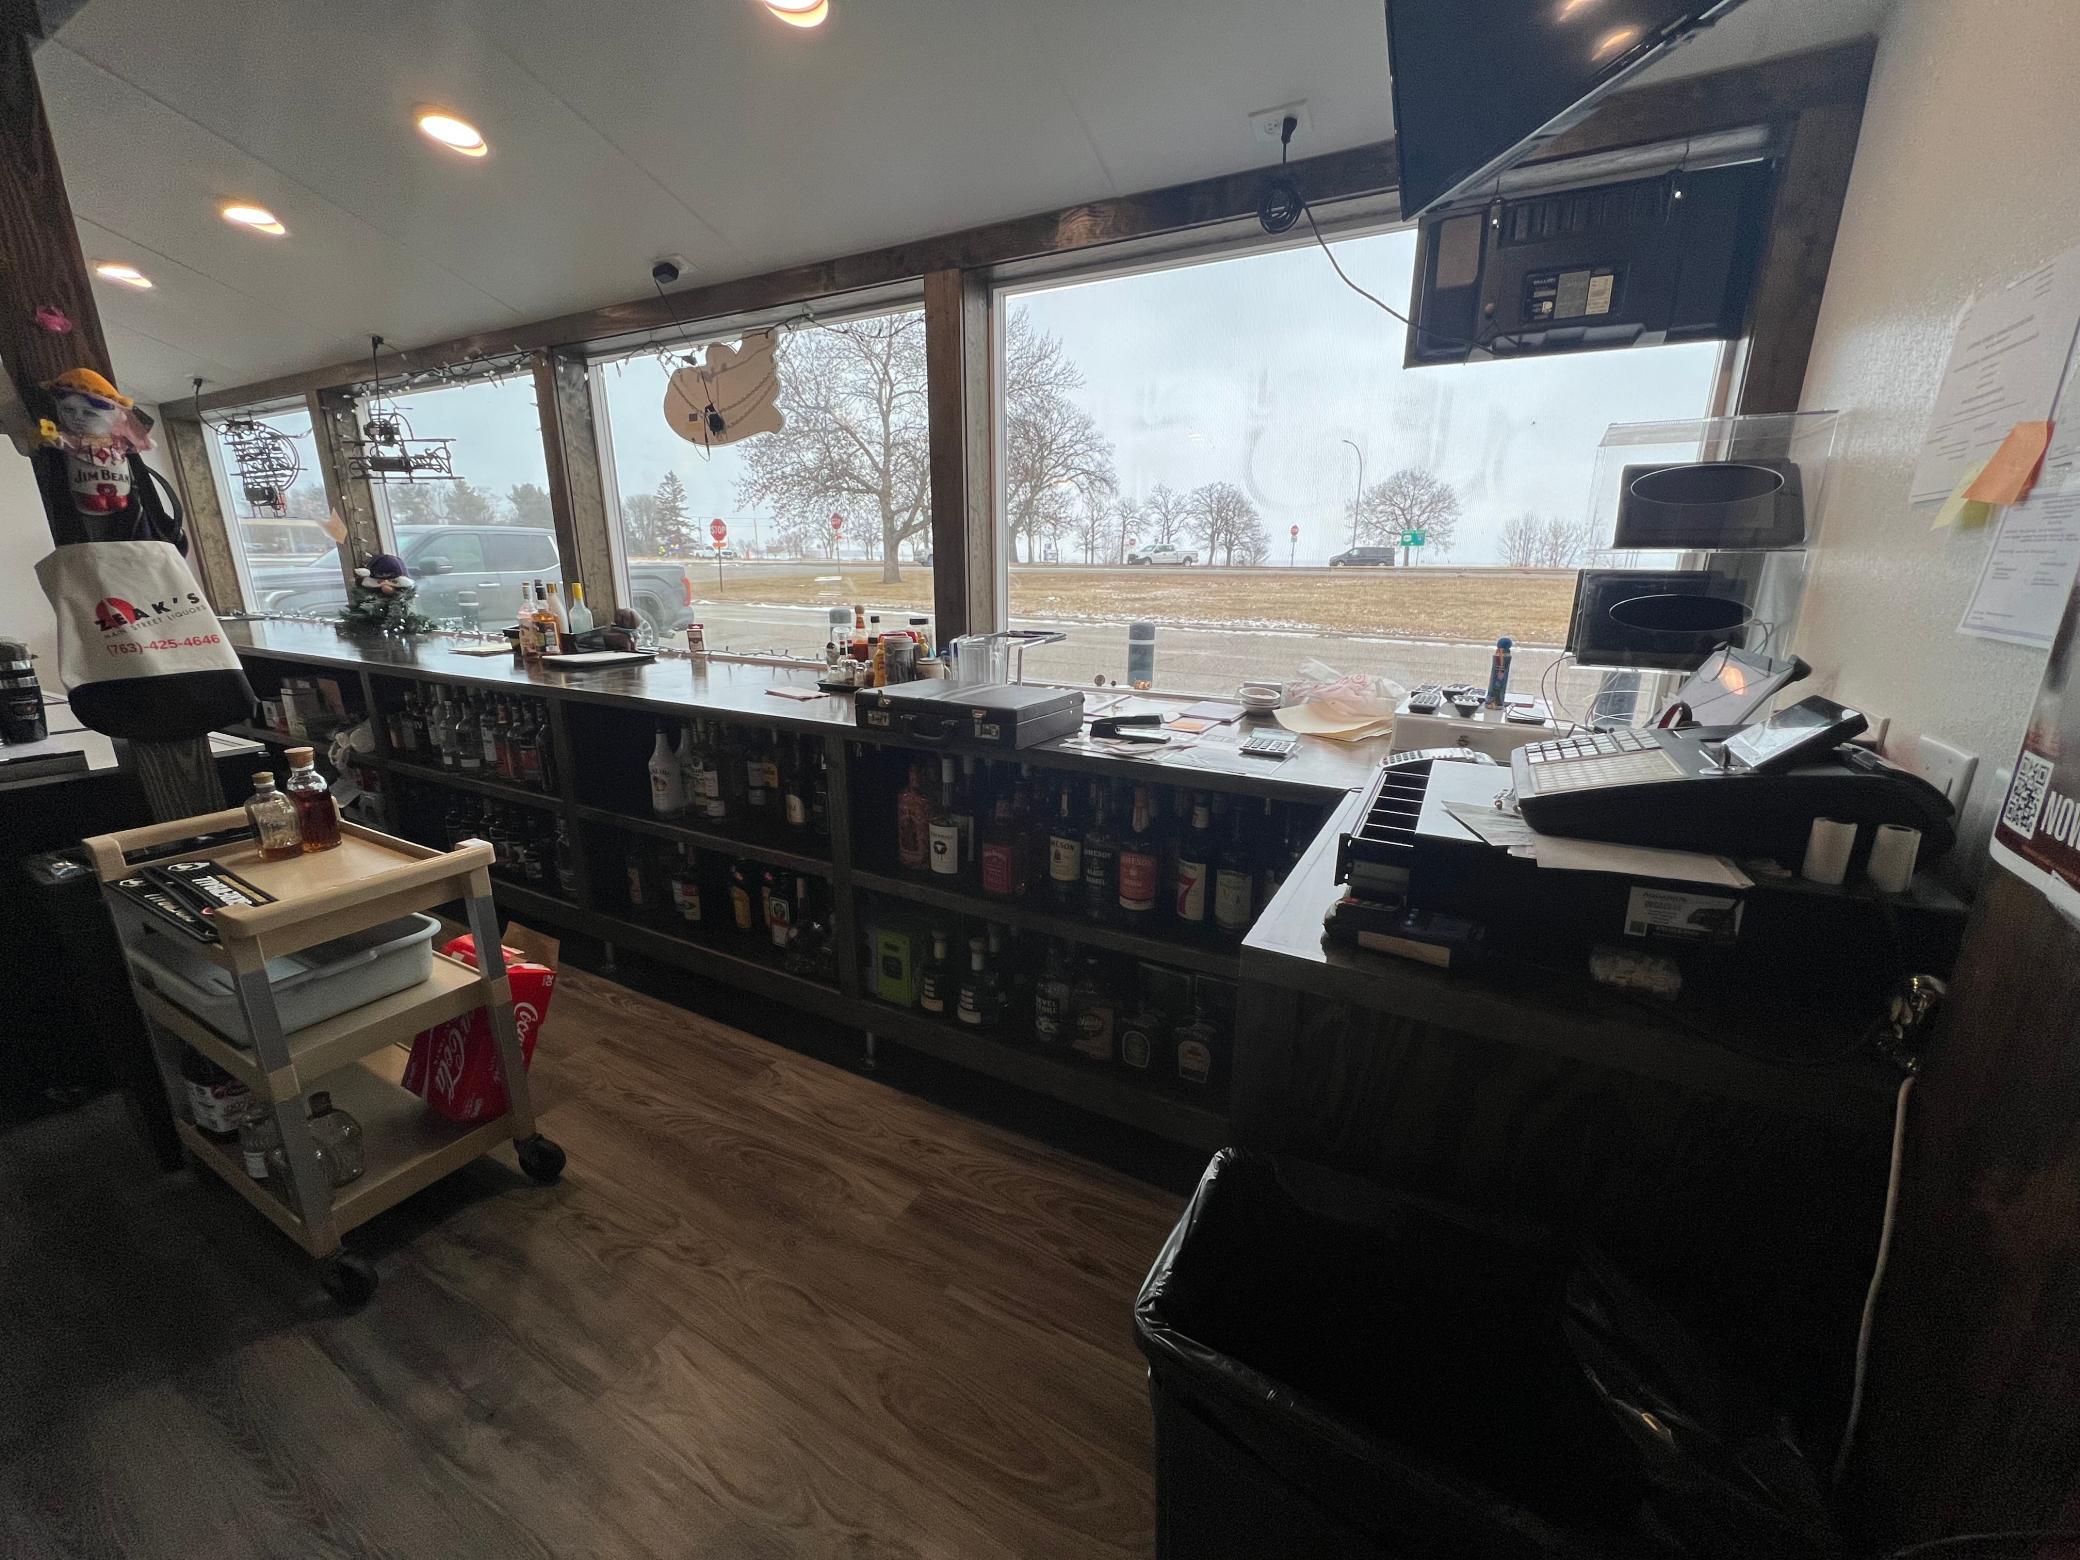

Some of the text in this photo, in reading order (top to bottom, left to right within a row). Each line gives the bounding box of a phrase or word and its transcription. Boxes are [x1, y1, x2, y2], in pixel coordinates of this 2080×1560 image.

[75, 470, 99, 484] JIM
[711, 525, 726, 535] STOP
[131, 616, 163, 631] STREET
[106, 634, 221, 656] (763)-425-4646
